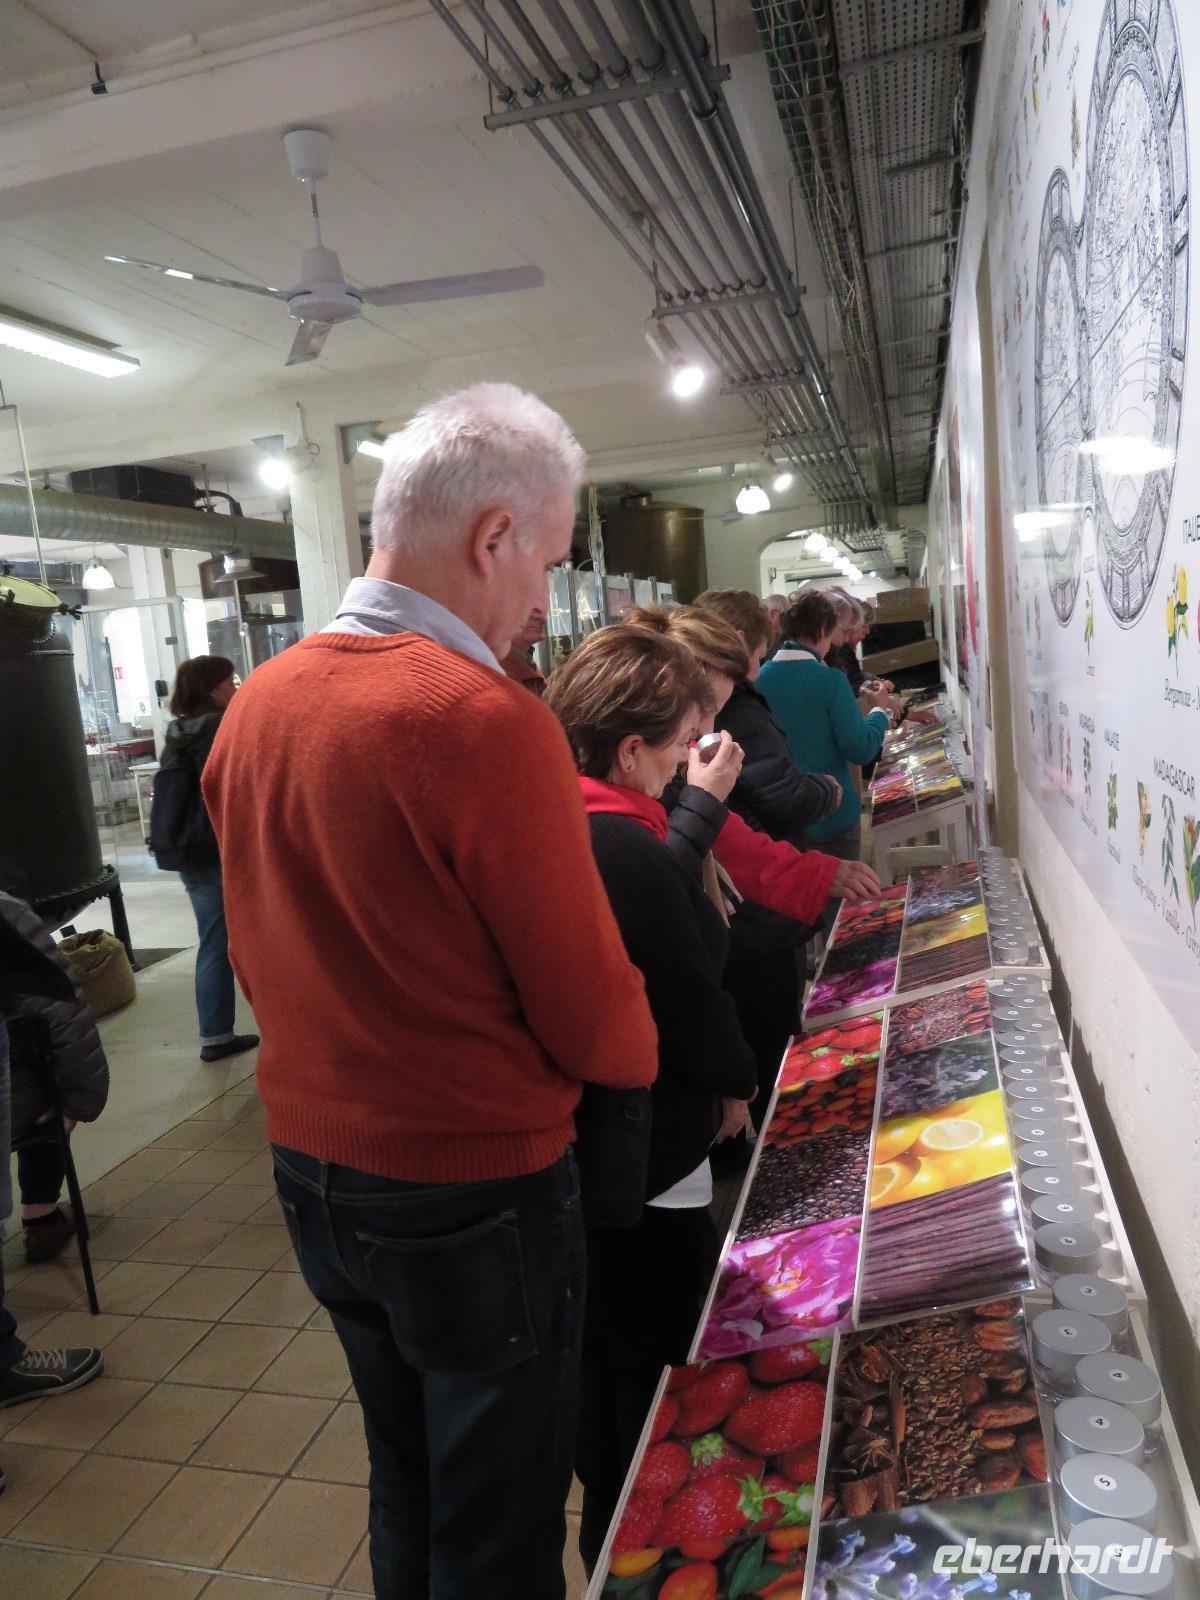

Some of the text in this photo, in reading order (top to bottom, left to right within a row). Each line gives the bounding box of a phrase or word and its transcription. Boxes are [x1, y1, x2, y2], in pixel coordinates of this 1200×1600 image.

[1153, 755, 1195, 801] MADAGASCAR
[1095, 1418, 1104, 1426] 4
[1099, 1477, 1111, 1487] 5
